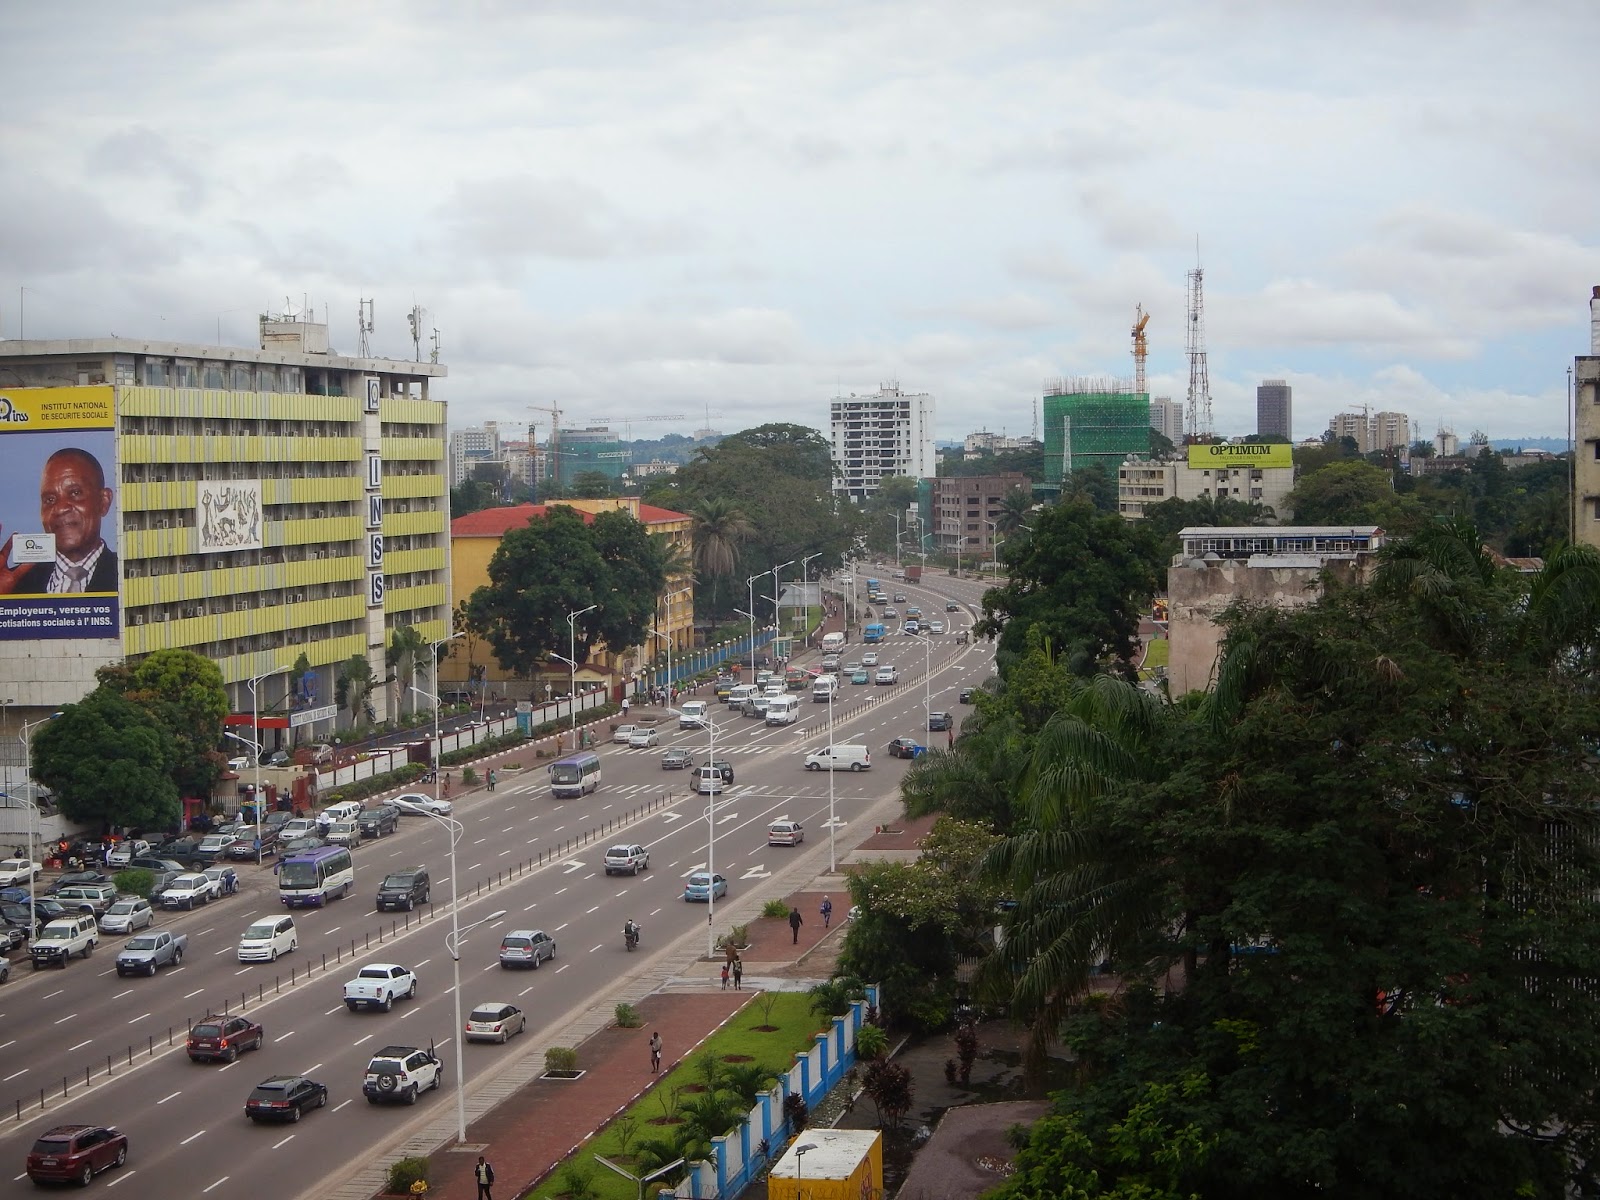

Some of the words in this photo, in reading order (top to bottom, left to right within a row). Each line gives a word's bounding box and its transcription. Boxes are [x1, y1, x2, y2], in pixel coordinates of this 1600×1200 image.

[73, 401, 108, 409] NATIONAL
[41, 413, 50, 421] DE
[82, 411, 108, 419] SOCIALE
[0, 606, 57, 617] Employeurs,
[42, 618, 75, 627] sociales
[77, 618, 83, 627] à
[91, 616, 113, 626] INSS.
